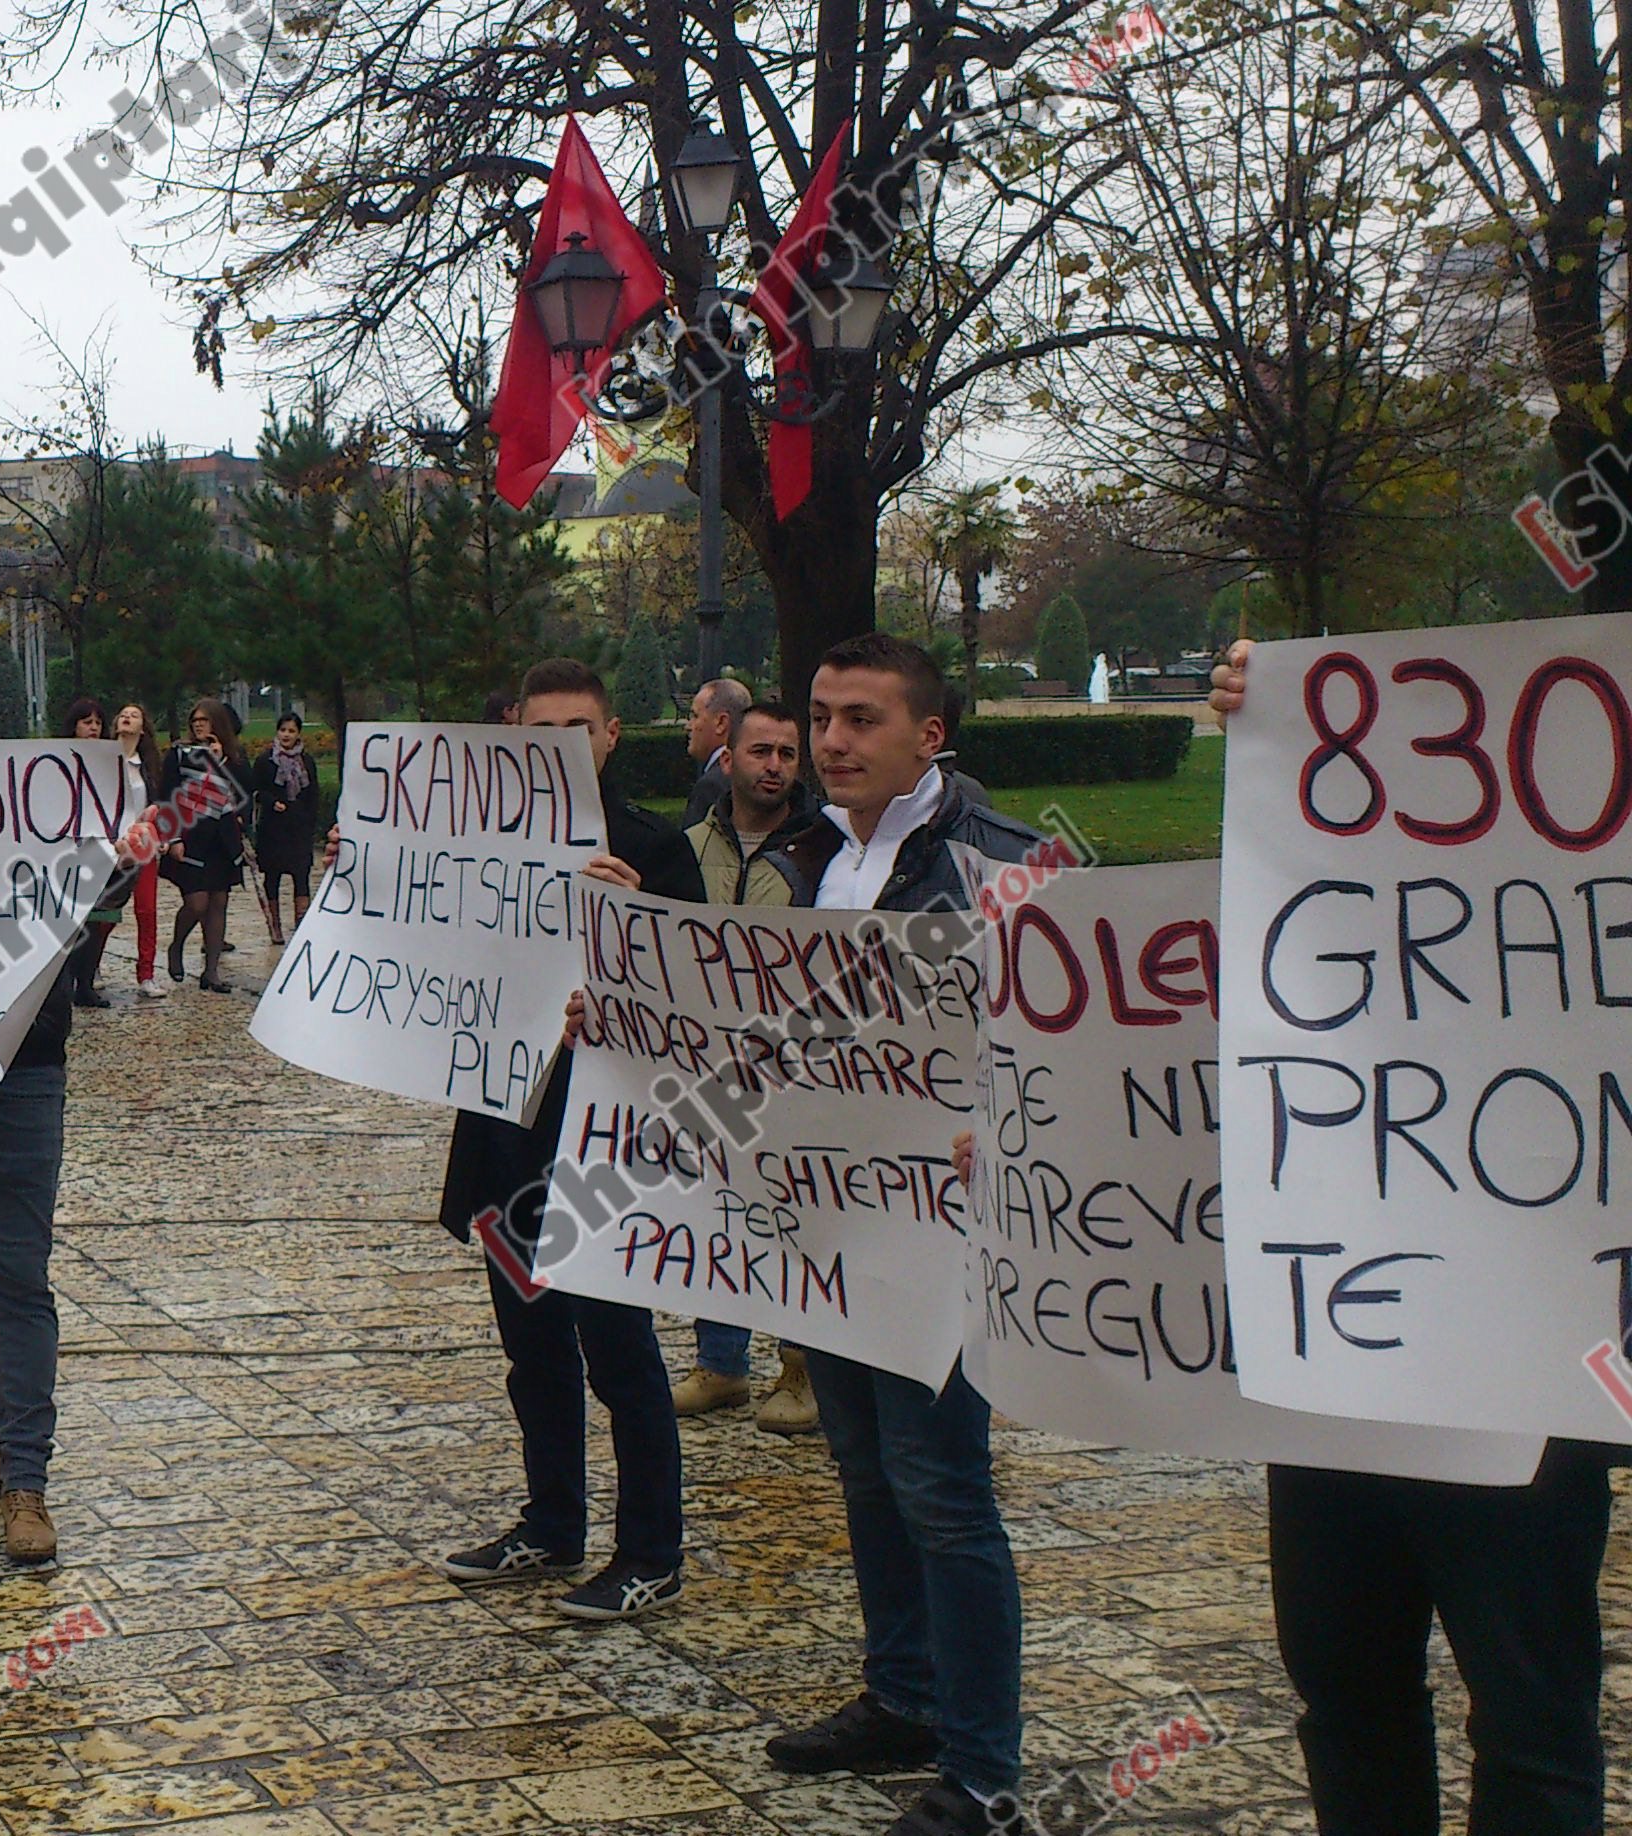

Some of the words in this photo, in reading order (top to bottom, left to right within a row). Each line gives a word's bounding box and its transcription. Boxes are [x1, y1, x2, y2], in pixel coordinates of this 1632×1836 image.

[356, 732, 598, 847] SKANDAL
[277, 938, 504, 1029] NDRYSHON
[677, 917, 904, 1026] PARKIMI
[713, 1024, 975, 1113] TREGTARE
[577, 1102, 730, 1186] HIQEN
[754, 1145, 968, 1237] SHTEPITE
[714, 1188, 801, 1250] PER
[613, 1212, 848, 1319] PARKIM
[1261, 1242, 1446, 1362] TE
